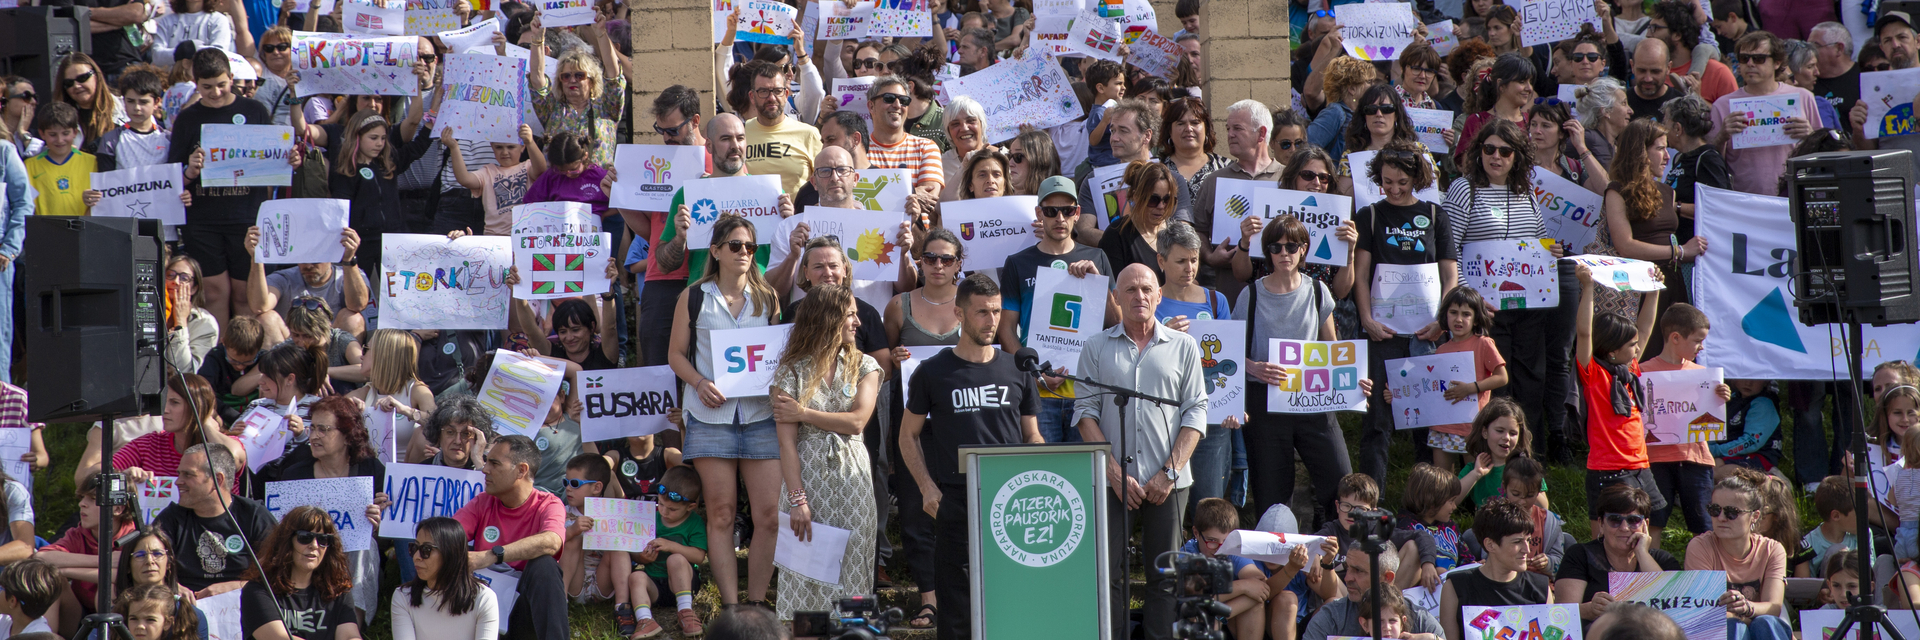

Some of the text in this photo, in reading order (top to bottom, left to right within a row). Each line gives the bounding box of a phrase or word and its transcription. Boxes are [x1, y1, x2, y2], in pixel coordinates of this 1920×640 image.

[543, 0, 587, 10] IKASTOLA
[746, 142, 791, 159] OINEZ
[93, 180, 172, 198] TORKIZUNA
[721, 198, 760, 209] LIZARRA
[979, 218, 1002, 228] JASO
[1264, 203, 1340, 229] Labiaga
[980, 227, 1027, 239] IKASTOLA
[724, 343, 766, 373] SF
[586, 390, 675, 418] EUSKARA
[952, 384, 1010, 408] OINEZ
[1210, 385, 1243, 410] IKASTOLA
[1288, 387, 1348, 407] ikastola
[1011, 494, 1062, 513] ATZERA
[993, 474, 1084, 564] EUSKARA ETORKIZUNA NAFARROA
[1005, 508, 1070, 527] PAUSORIK
[1024, 524, 1054, 544] EZ!
